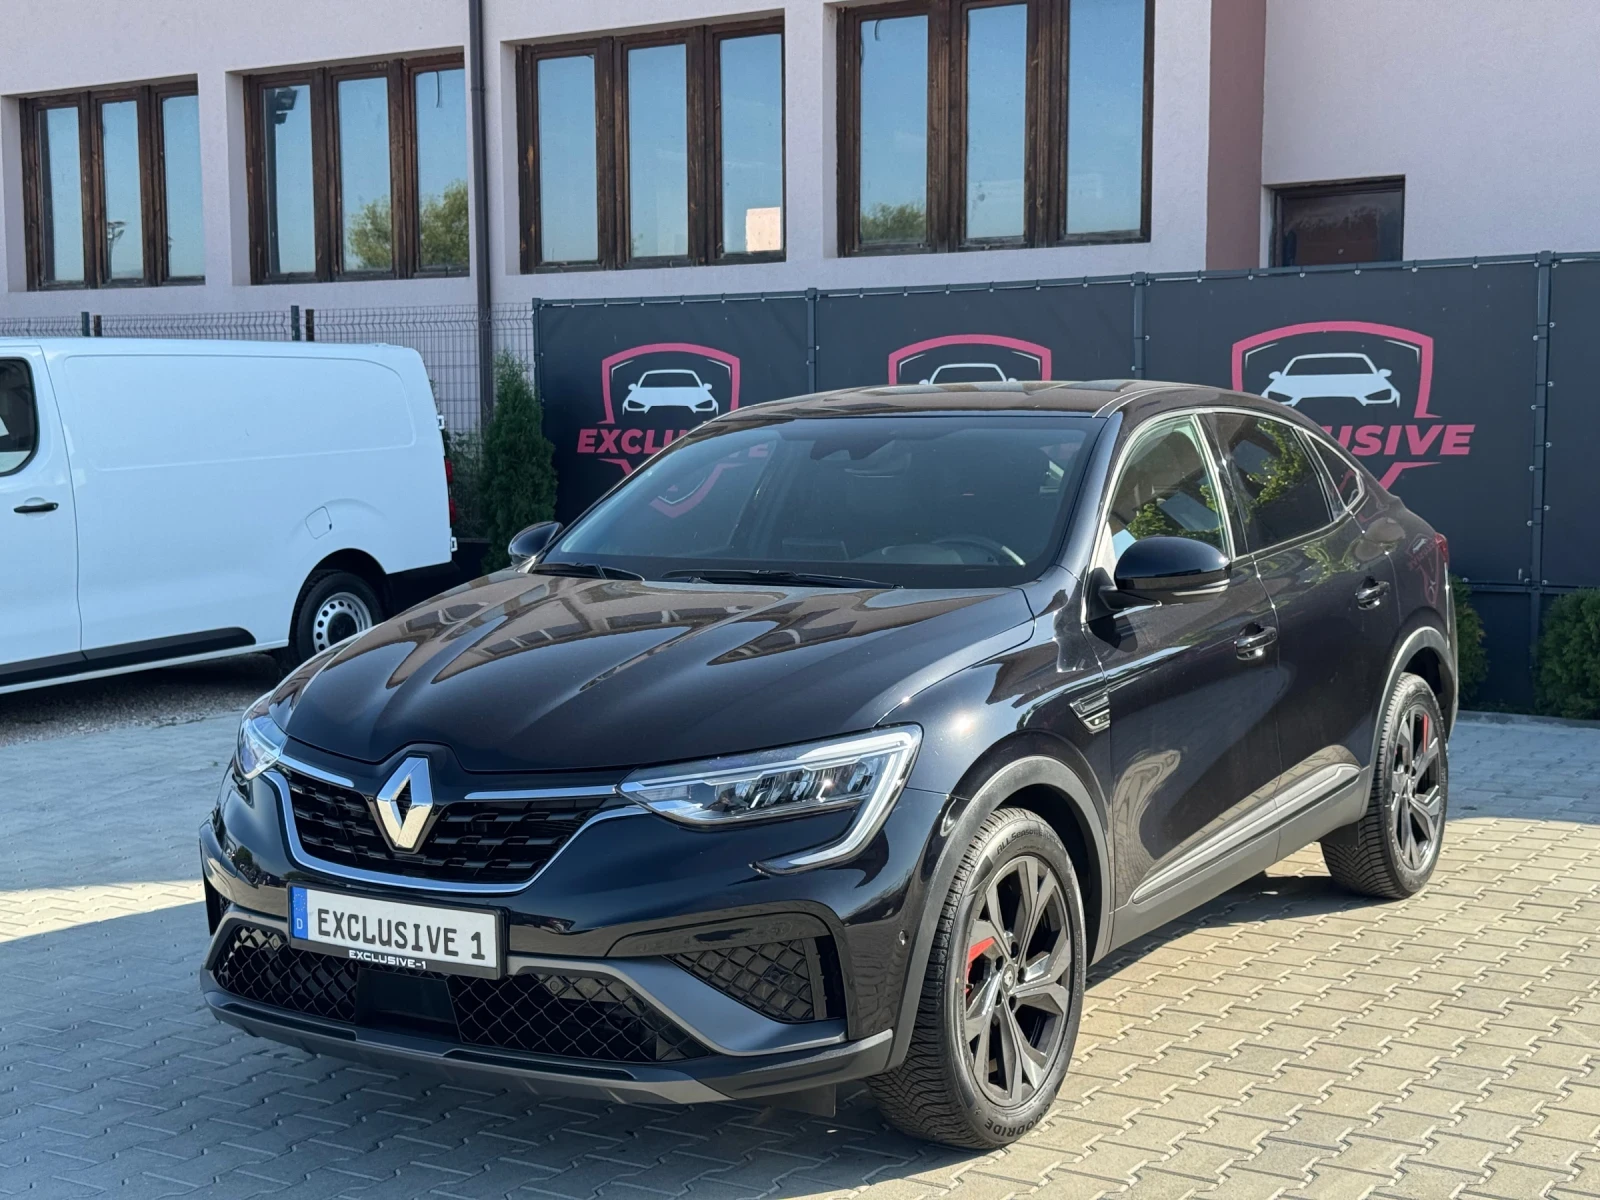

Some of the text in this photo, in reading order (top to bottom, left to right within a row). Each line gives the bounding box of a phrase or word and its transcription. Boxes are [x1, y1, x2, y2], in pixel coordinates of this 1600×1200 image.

[296, 917, 303, 930] D
[317, 908, 486, 961] EXCLUSIVE 1
[348, 949, 427, 970] EXCLUSIVE-1
